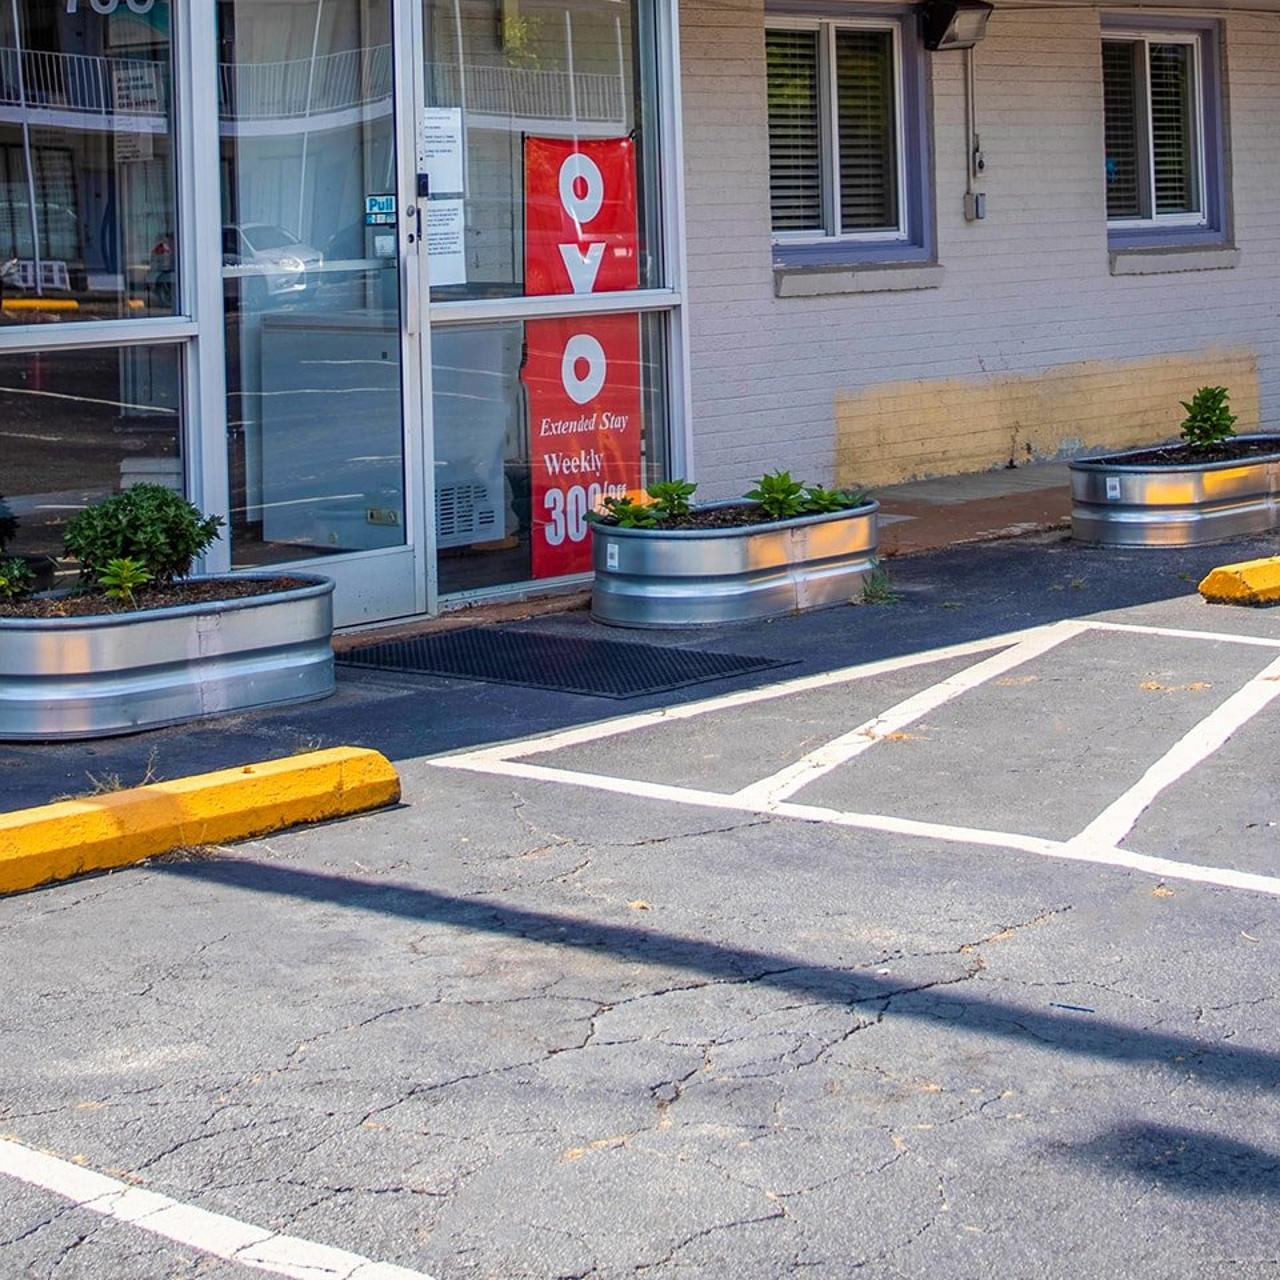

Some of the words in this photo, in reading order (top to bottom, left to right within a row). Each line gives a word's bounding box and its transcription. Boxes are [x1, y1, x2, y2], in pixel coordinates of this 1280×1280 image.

[369, 197, 394, 212] Pull
[558, 152, 607, 405] OYO
[540, 413, 597, 436] Extended
[599, 411, 628, 432] Stay
[543, 449, 604, 477] Weekly
